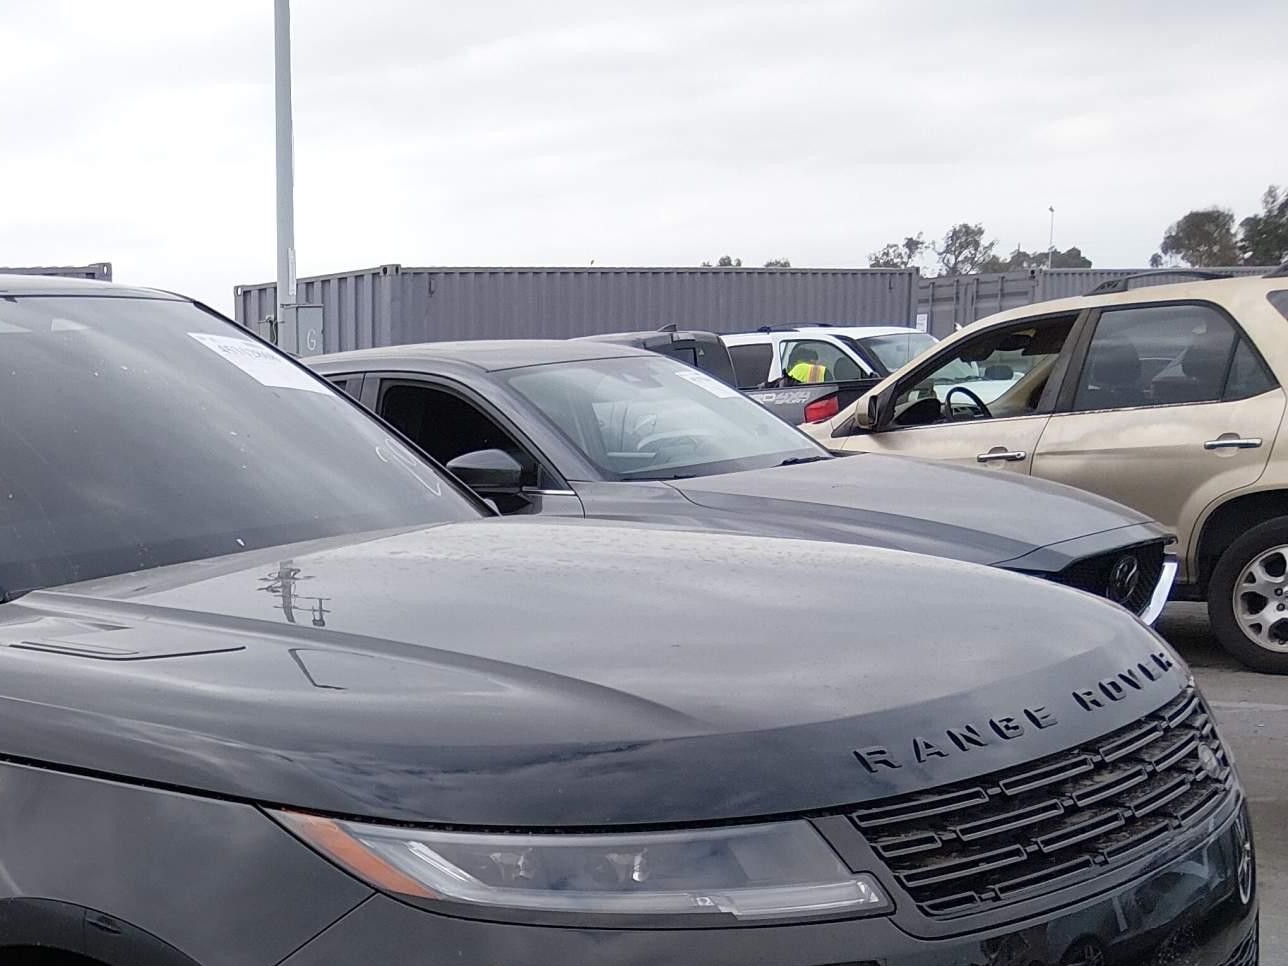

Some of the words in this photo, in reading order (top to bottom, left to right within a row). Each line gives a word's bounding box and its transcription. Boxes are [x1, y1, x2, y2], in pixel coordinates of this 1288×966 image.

[306, 328, 316, 351] G
[853, 705, 1059, 774] RANGE
[1070, 651, 1173, 712] ROVER
